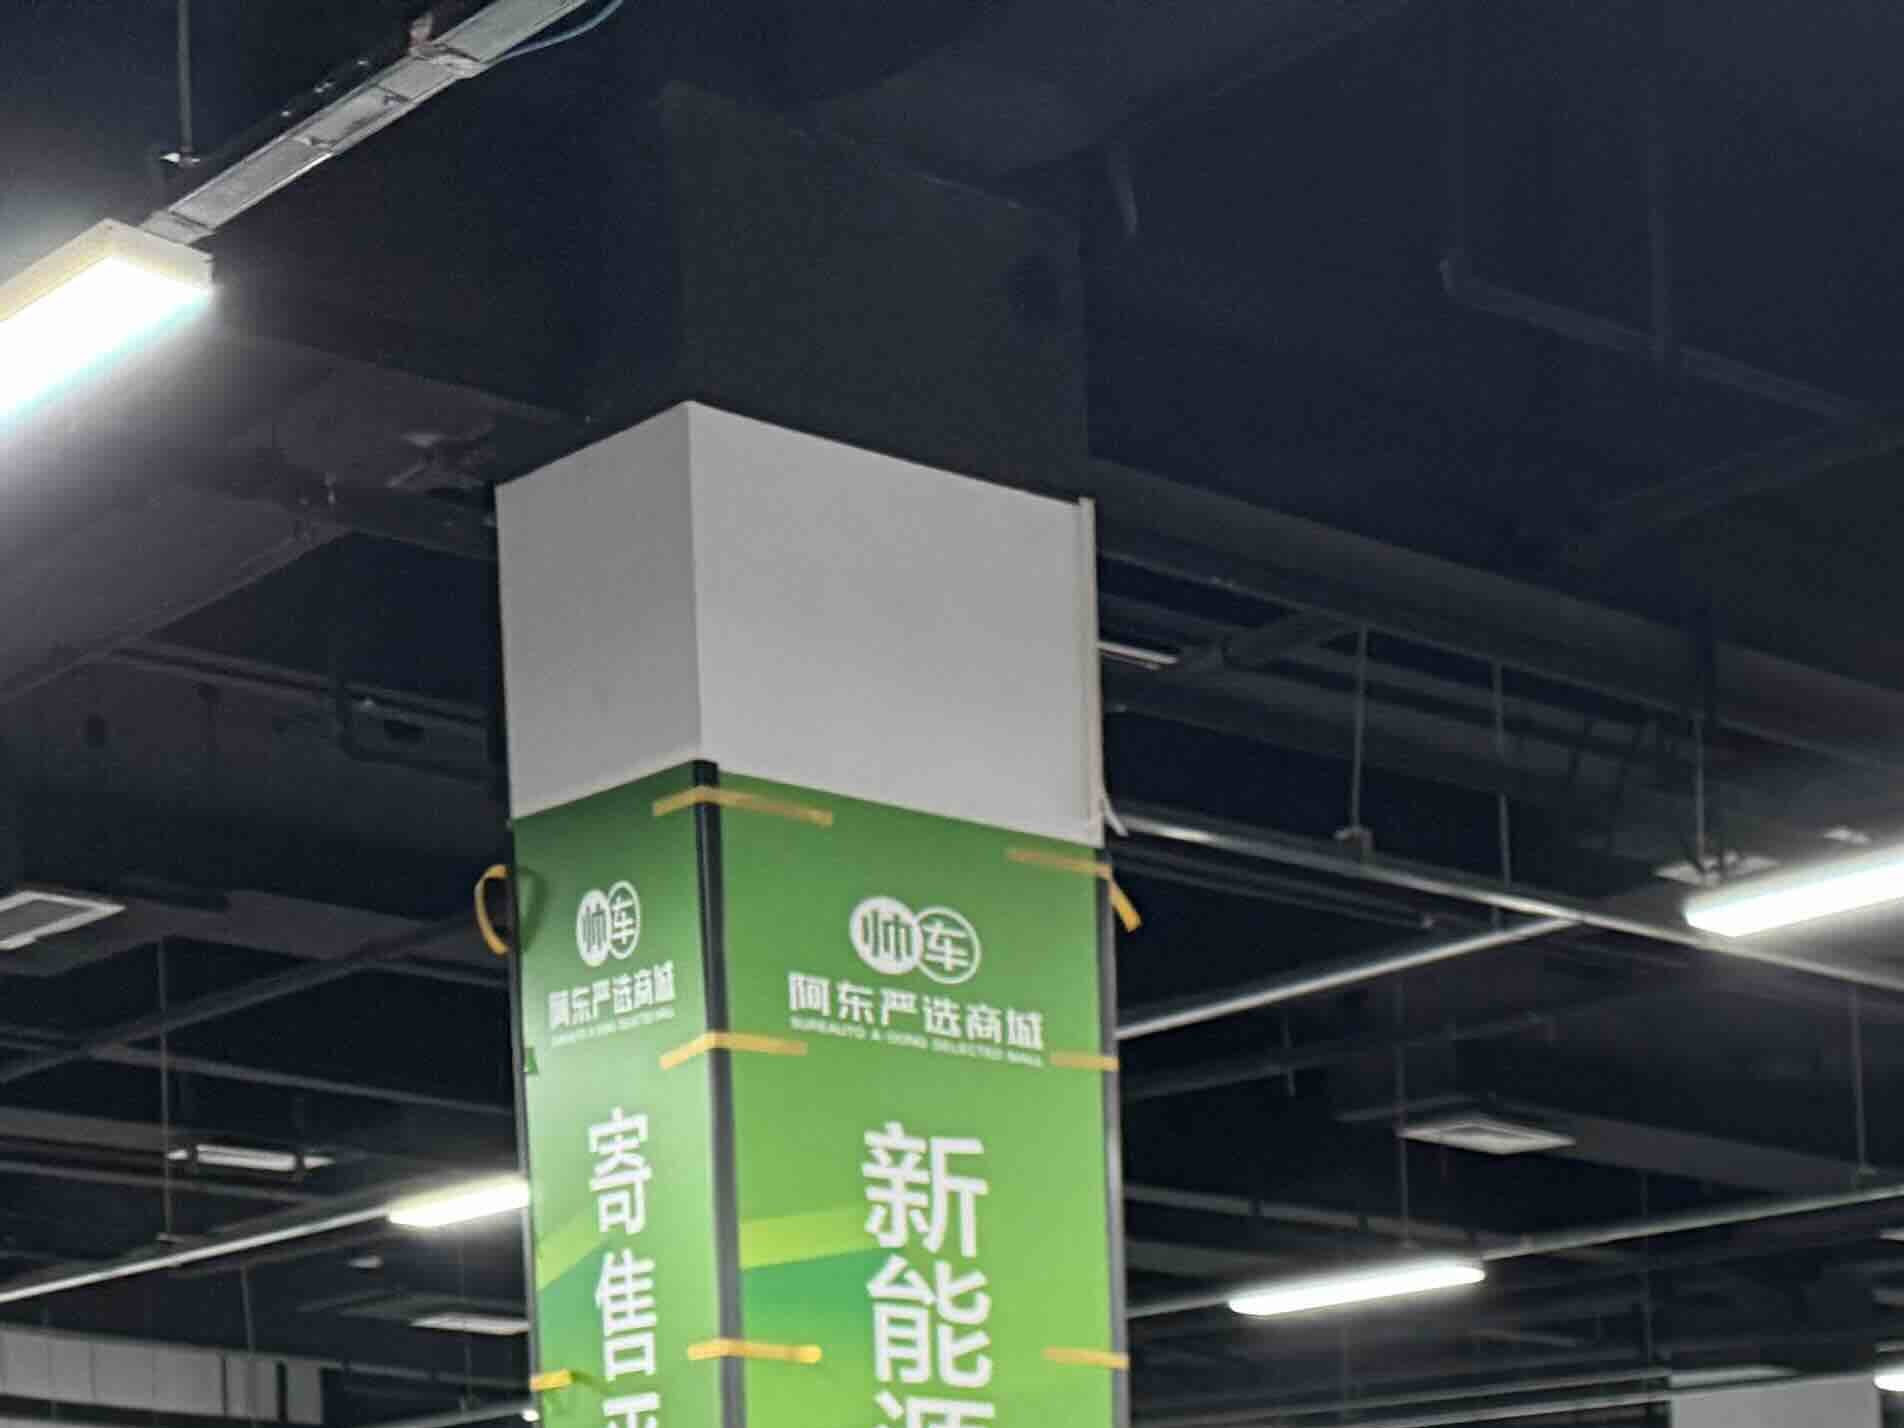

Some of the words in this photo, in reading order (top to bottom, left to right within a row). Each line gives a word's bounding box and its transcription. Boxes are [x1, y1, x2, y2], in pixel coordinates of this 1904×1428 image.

[787, 971, 1044, 1050] 阿东严选商城
